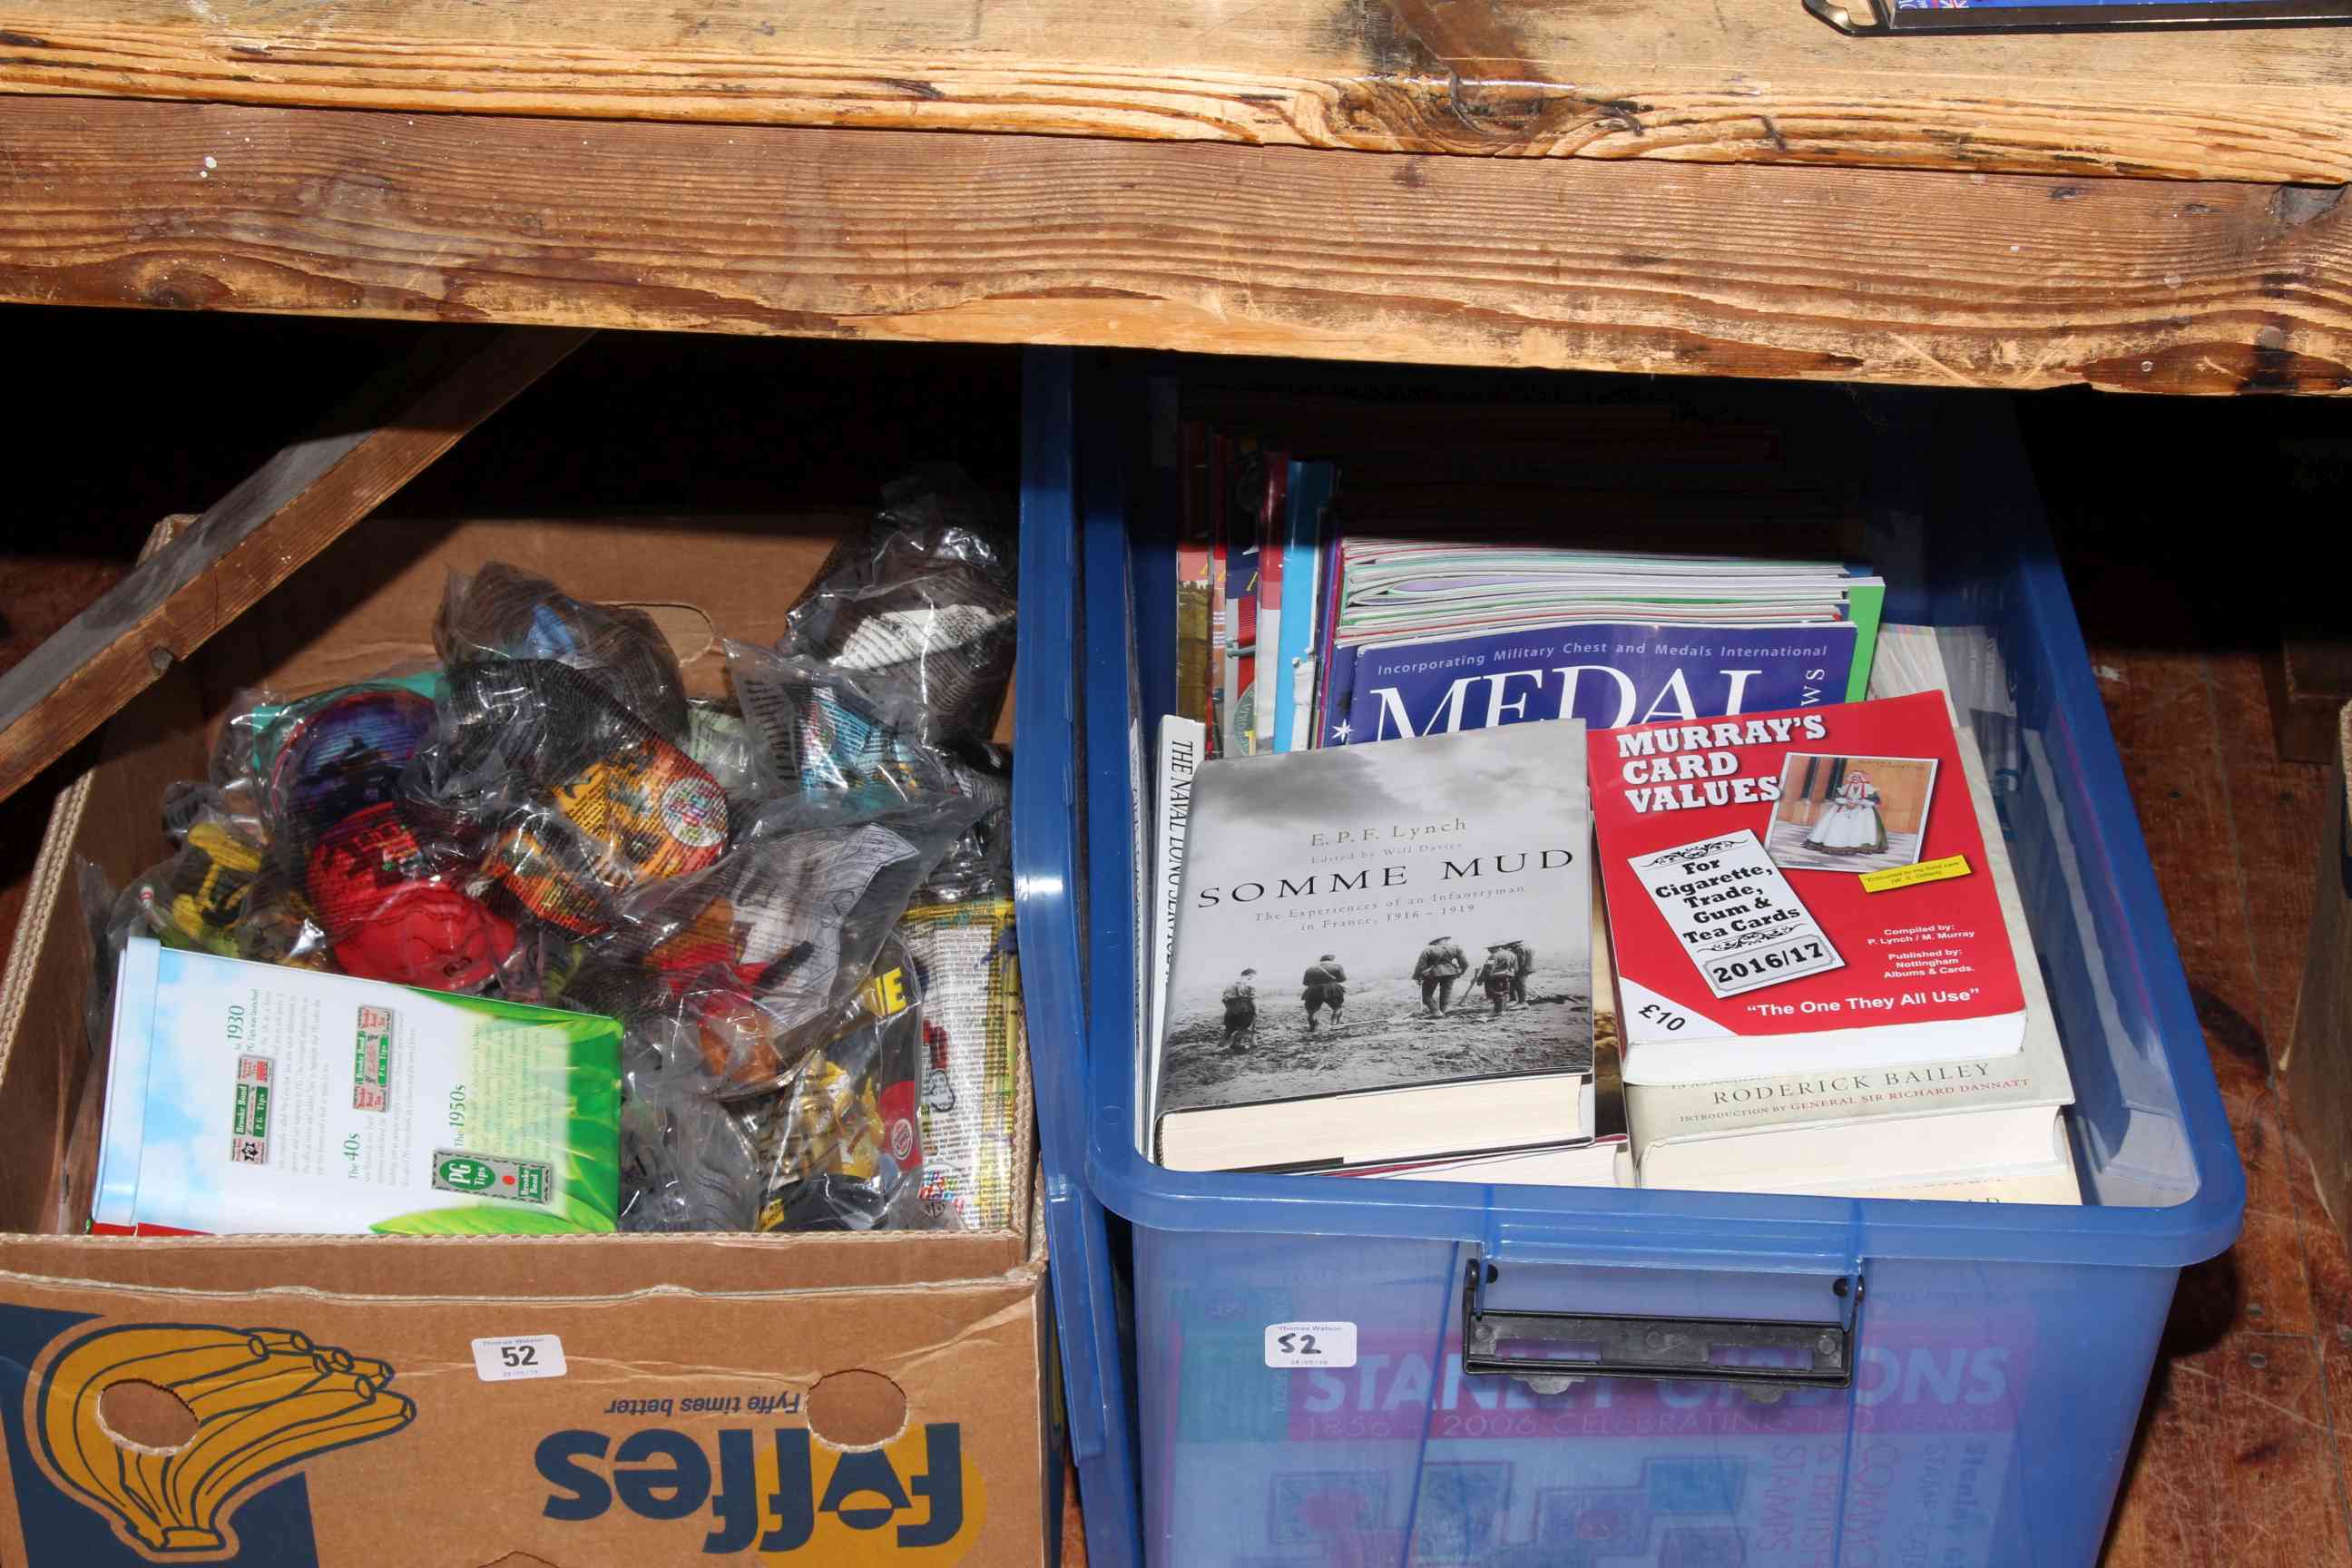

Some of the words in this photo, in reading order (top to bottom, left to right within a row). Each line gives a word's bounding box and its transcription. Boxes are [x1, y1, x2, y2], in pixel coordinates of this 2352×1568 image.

[1377, 652, 1485, 676] Incorporating
[1493, 644, 1556, 662] Military
[1563, 642, 1608, 656] Chest
[1616, 642, 1647, 656] and
[1655, 642, 1712, 658] Medals
[1720, 643, 1828, 658] International
[1800, 668, 1826, 707] WS
[1616, 715, 1827, 758] MURRAY’S
[1171, 740, 1193, 775] THE
[1622, 751, 1739, 785] CARD
[1168, 776, 1191, 832] NAVAL
[1624, 776, 1781, 813] VALUES
[1311, 832, 1329, 848] E.
[1338, 830, 1356, 844] P.
[1363, 828, 1380, 841] F.
[1393, 818, 1467, 839] Lynch
[1310, 853, 1354, 865] Edited
[1358, 851, 1377, 863] by
[1681, 858, 1720, 876] For
[1197, 865, 1408, 908] SOMME
[1441, 848, 1574, 881] MUD
[1655, 866, 1774, 898] Cigarette,
[1255, 911, 1282, 923] The
[1289, 901, 1378, 920] Experiences
[1385, 897, 1402, 908] of
[1408, 897, 1425, 906] an
[1431, 884, 1526, 906] Infantryman
[1682, 884, 1764, 909] Trade,
[1300, 921, 1315, 931] in
[1322, 916, 1380, 931] France,
[1386, 910, 1419, 922] 1916
[1441, 904, 1476, 916] 1919
[1693, 904, 1751, 925] Gum
[1754, 897, 1772, 909] &
[1682, 926, 1726, 945] Tea
[1730, 907, 1801, 933] Cards
[1867, 937, 1877, 946] P.
[1879, 934, 1914, 946] Lynch
[1922, 933, 1935, 942] M.
[1937, 929, 1975, 941] Murray
[1884, 924, 1935, 936] Compiled
[1936, 923, 1955, 935] by:
[1713, 942, 1824, 984] 2016/17
[1887, 949, 1942, 961] Published
[1944, 948, 1963, 959] by:
[1895, 957, 1959, 970] Nottingham
[1884, 967, 1926, 979] Albums
[1928, 967, 1937, 975] &
[1939, 965, 1975, 975] Cards.
[1747, 1000, 1797, 1017] “The
[1800, 998, 1841, 1014] One
[1846, 995, 1894, 1012] They
[1901, 991, 1927, 1005] All
[1932, 987, 1980, 1004] Use”
[226, 1004, 246, 1041] 1930
[1638, 1004, 1686, 1032] £10
[237, 1084, 248, 1105] Bond
[1712, 1075, 1872, 1105] RODERICK
[1885, 1061, 1993, 1087] BAILEY
[256, 1093, 267, 1112] Tips
[448, 1083, 466, 1128] 1950s
[1679, 1104, 1769, 1123] INTRODUCTION
[1772, 1103, 1787, 1112] BY
[1790, 1096, 1858, 1112] GENERAL
[1860, 1093, 1886, 1104] SIR
[1888, 1084, 1955, 1101] RICHARD
[1959, 1077, 2032, 1095] DANNATT
[236, 1106, 246, 1133] Brooke
[343, 1132, 360, 1161] 40s
[454, 1132, 465, 1147] The
[348, 1163, 358, 1181] The
[448, 1163, 472, 1184] PG
[474, 1166, 487, 1186] Tips
[520, 1168, 531, 1195] Brooke
[530, 1173, 539, 1194] Bond
[1278, 1324, 1310, 1332] Thomas
[1312, 1324, 1344, 1332] Watson
[501, 1345, 539, 1367] 52
[1278, 1332, 1321, 1354] 52
[1304, 1350, 1624, 1413] STAN
[1654, 1347, 2012, 1407] GONS
[603, 1397, 674, 1417] better
[681, 1395, 741, 1416] times
[748, 1390, 801, 1416] Fyffe
[534, 1422, 965, 1553] Fyffes
